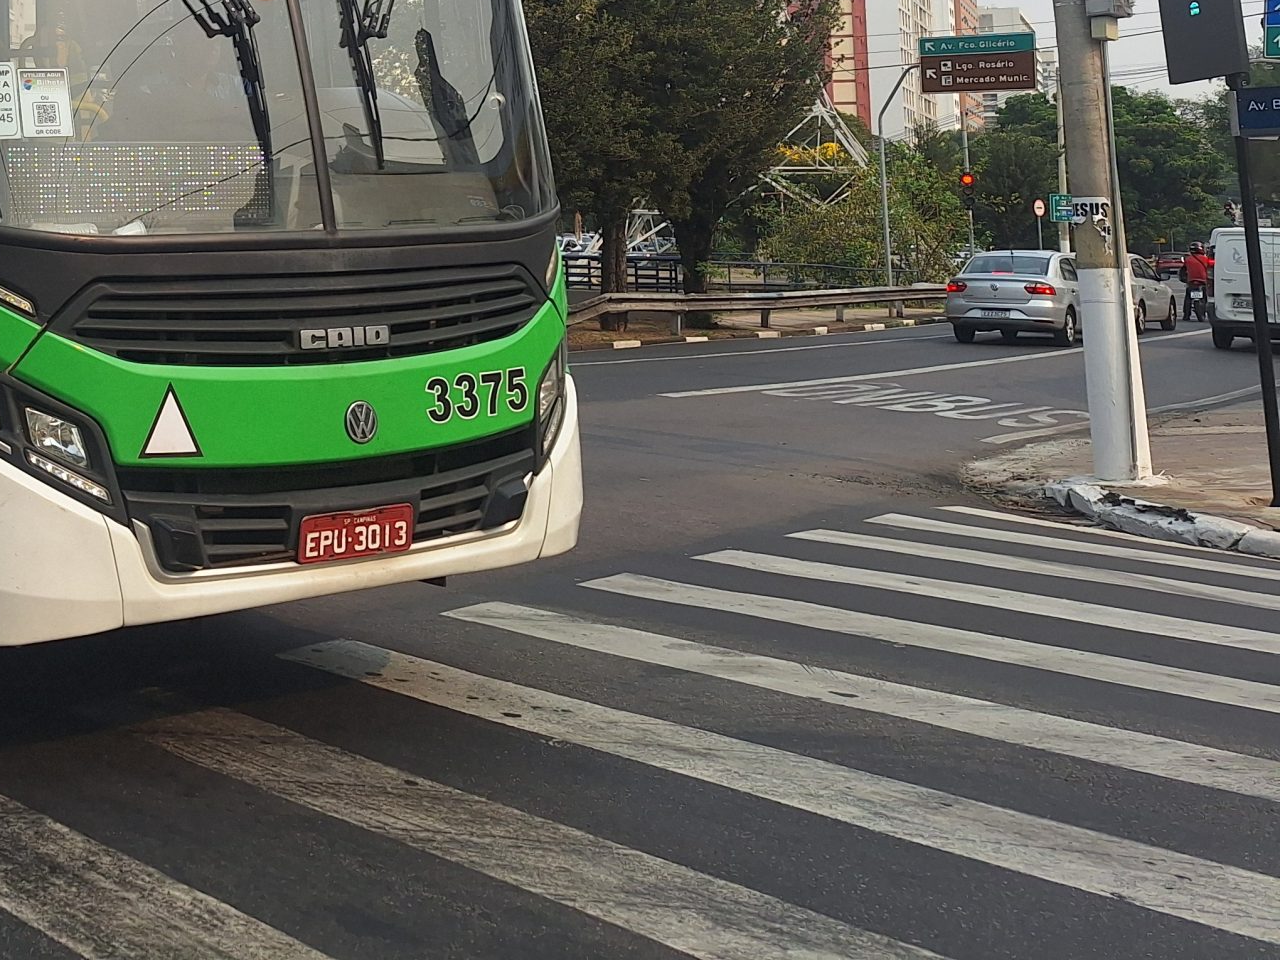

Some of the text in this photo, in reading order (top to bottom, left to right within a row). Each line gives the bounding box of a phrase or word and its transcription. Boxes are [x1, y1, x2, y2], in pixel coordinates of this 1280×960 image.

[979, 40, 1015, 48] Glicério
[955, 60, 1014, 71] Lgo. Rosário
[956, 74, 1030, 84] Mercado Munic.
[1248, 100, 1268, 111] Av.
[300, 325, 390, 350] CAIO
[425, 366, 529, 424] 3375
[353, 515, 377, 524] CAMPINAS
